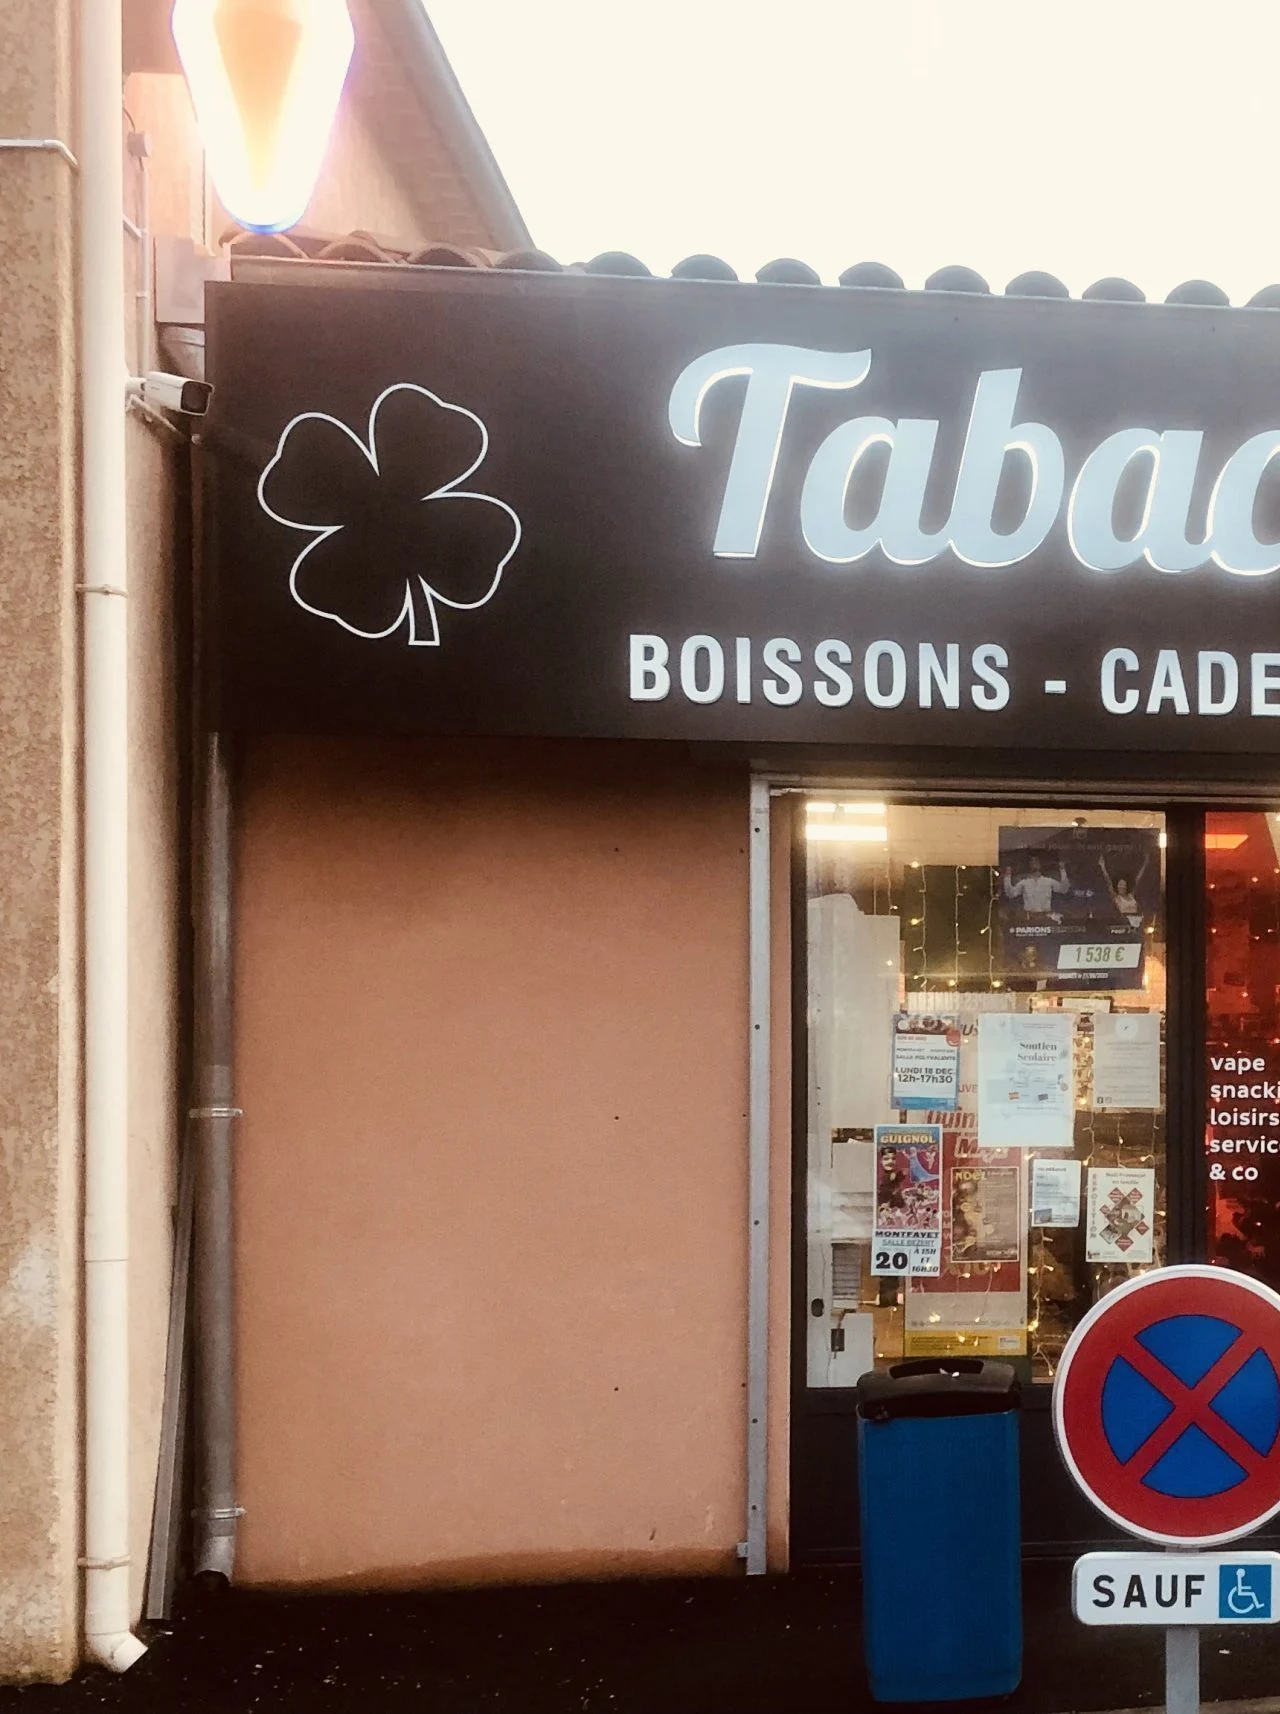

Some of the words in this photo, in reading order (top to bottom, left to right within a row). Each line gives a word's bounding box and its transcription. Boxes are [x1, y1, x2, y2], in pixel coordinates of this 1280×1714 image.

[628, 634, 1012, 714] BOISSONS
[1019, 1041, 1057, 1051] Soutien
[1017, 1053, 1057, 1062] Scolaire
[1210, 1057, 1266, 1075] vape
[895, 1067, 922, 1075] LUNDI
[925, 1067, 933, 1075] 18
[898, 1074, 953, 1084] 12h-17h30
[1210, 1107, 1280, 1126] loisirs
[880, 1133, 937, 1145] GUIGNOL
[1209, 1163, 1227, 1181] &
[1231, 1166, 1259, 1181] co
[876, 1251, 908, 1270] 20
[1092, 1574, 1206, 1609] SAUF
